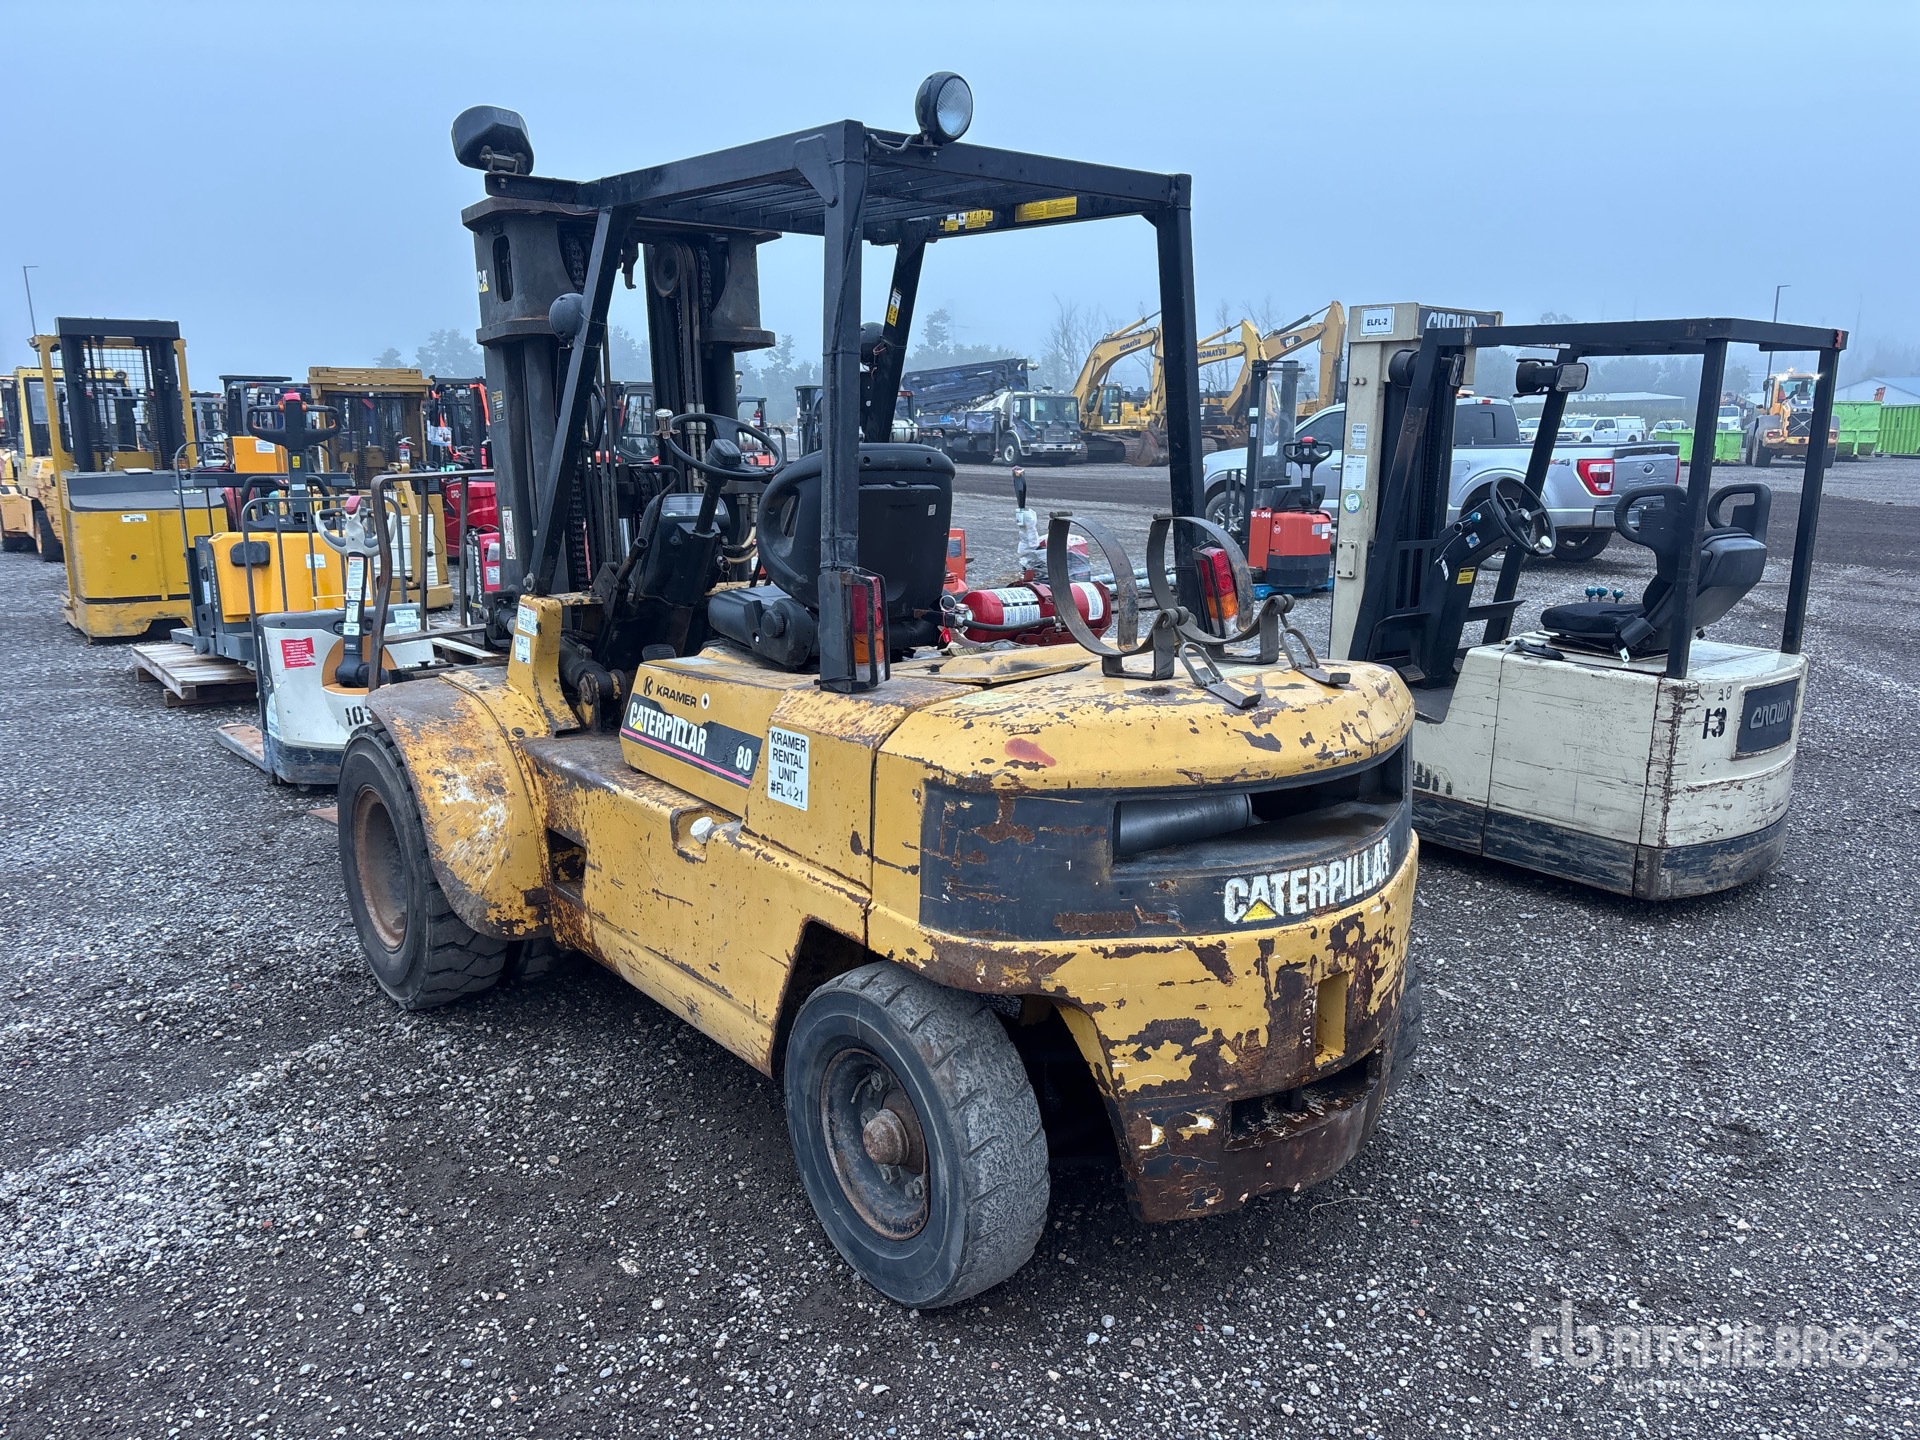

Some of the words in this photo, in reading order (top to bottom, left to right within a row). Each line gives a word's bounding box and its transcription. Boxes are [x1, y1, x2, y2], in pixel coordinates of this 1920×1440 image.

[1366, 318, 1388, 327] ELFL-2
[1119, 337, 1141, 352] KOMATSU
[656, 684, 697, 708] KRAMER
[1749, 699, 1792, 730] CROWN
[628, 702, 708, 757] CATERPILLAR
[771, 731, 807, 753] KRAMER
[735, 745, 753, 772] 80
[772, 747, 804, 769] RENTAL
[778, 766, 798, 784] UNIT
[1224, 833, 1391, 924] CATERPILLAR
